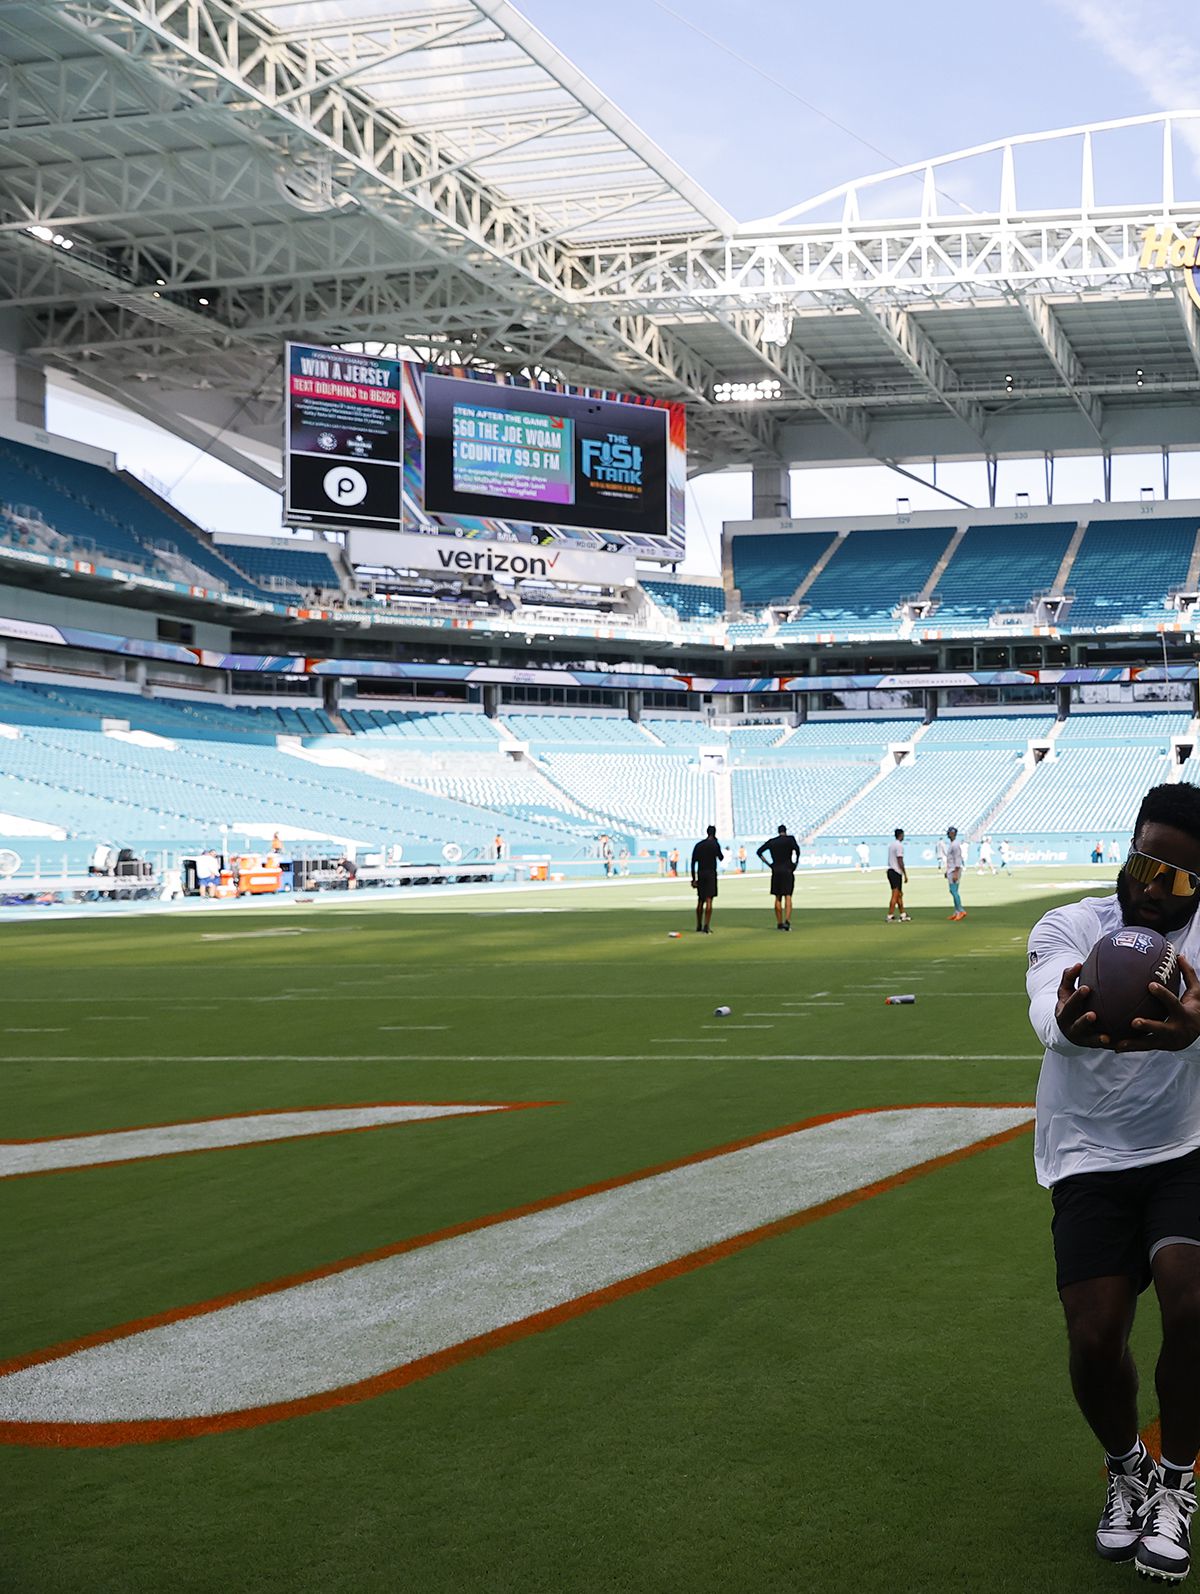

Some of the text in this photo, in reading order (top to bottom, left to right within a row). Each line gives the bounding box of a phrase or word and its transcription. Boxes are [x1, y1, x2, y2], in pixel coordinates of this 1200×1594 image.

[301, 357, 390, 387] WIN A JERSEY
[294, 378, 314, 393] TEXT
[315, 381, 357, 399] DOLPHINS
[476, 410, 504, 421] AFTER
[523, 416, 548, 427] GAME
[453, 418, 561, 449] 560 THE JOE WQAM
[607, 433, 628, 444] THE
[460, 441, 512, 464] COUNTRY
[515, 449, 540, 468] 99.9
[543, 453, 560, 470] FM
[593, 465, 642, 484] TANK
[419, 524, 439, 535] PHI
[454, 527, 464, 538] 0
[437, 548, 547, 576] verizon
[800, 853, 853, 867] olphins
